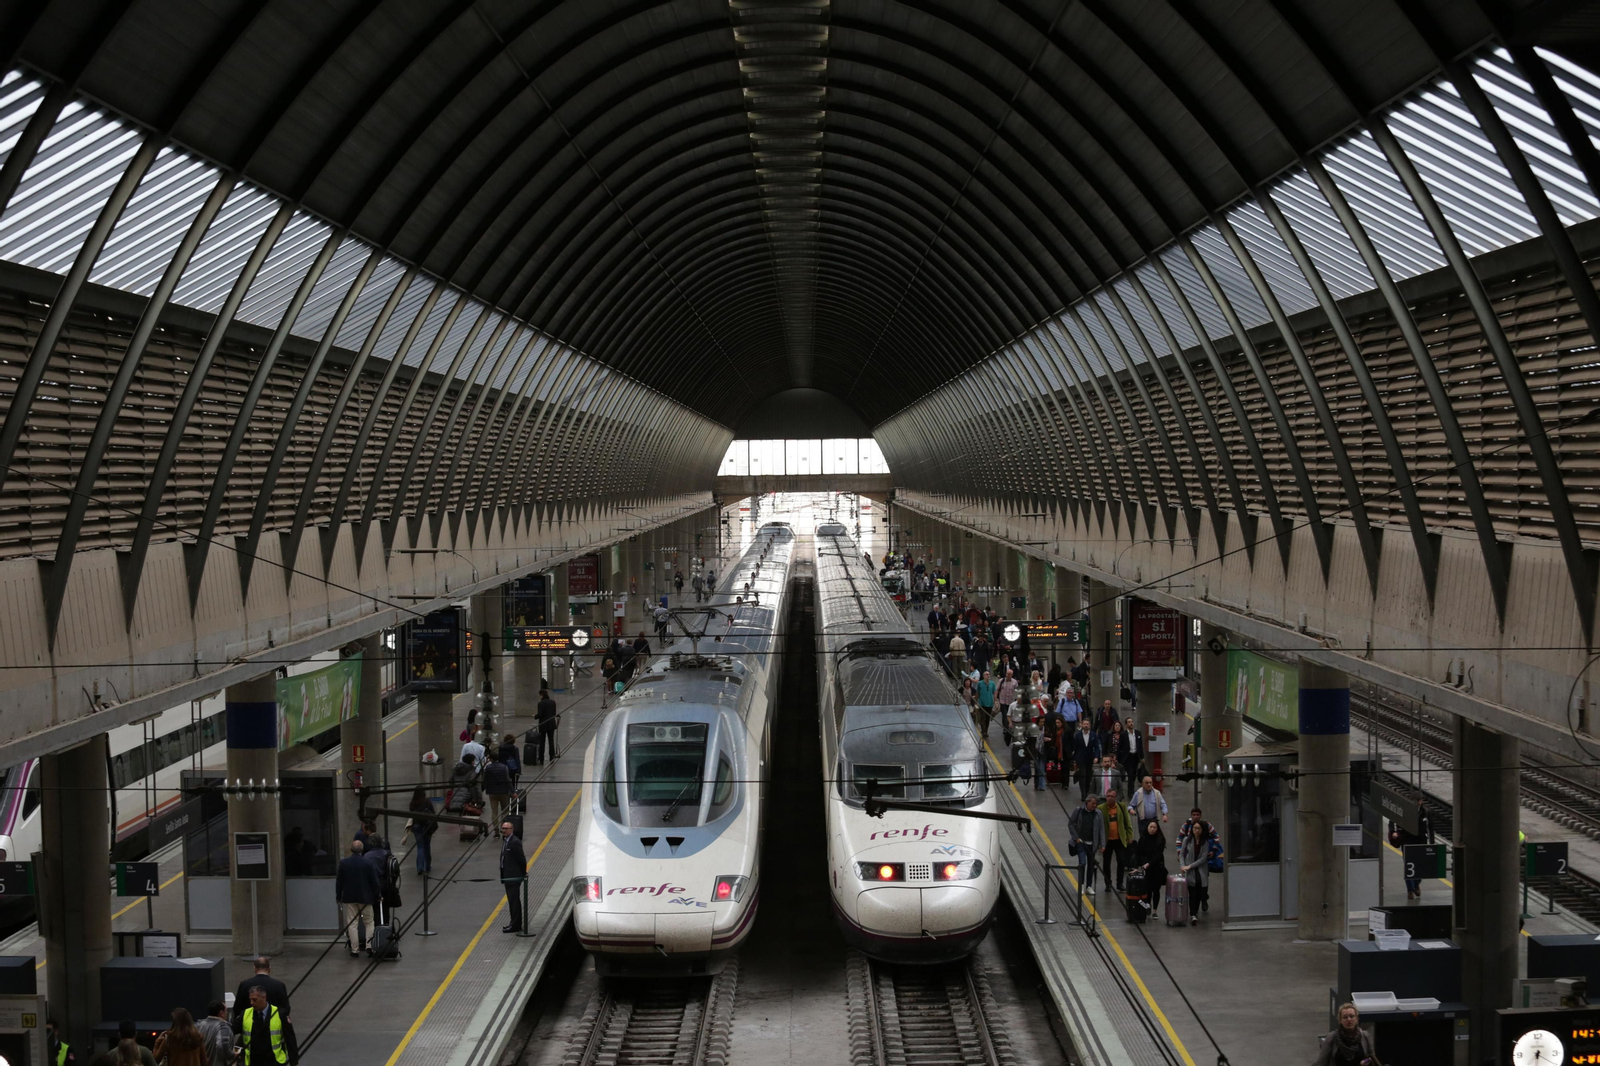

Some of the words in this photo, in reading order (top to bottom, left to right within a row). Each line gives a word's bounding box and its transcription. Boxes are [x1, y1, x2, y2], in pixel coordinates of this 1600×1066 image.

[1152, 620, 1166, 632] SÍ
[514, 639, 521, 648] 4
[1072, 632, 1079, 642] 3
[870, 824, 948, 840] renfe
[930, 846, 971, 857] AVE
[1406, 862, 1415, 878] 3
[1558, 858, 1566, 874] 2
[146, 879, 156, 894] 4
[606, 882, 686, 896] renfe
[668, 897, 708, 908] AVE
